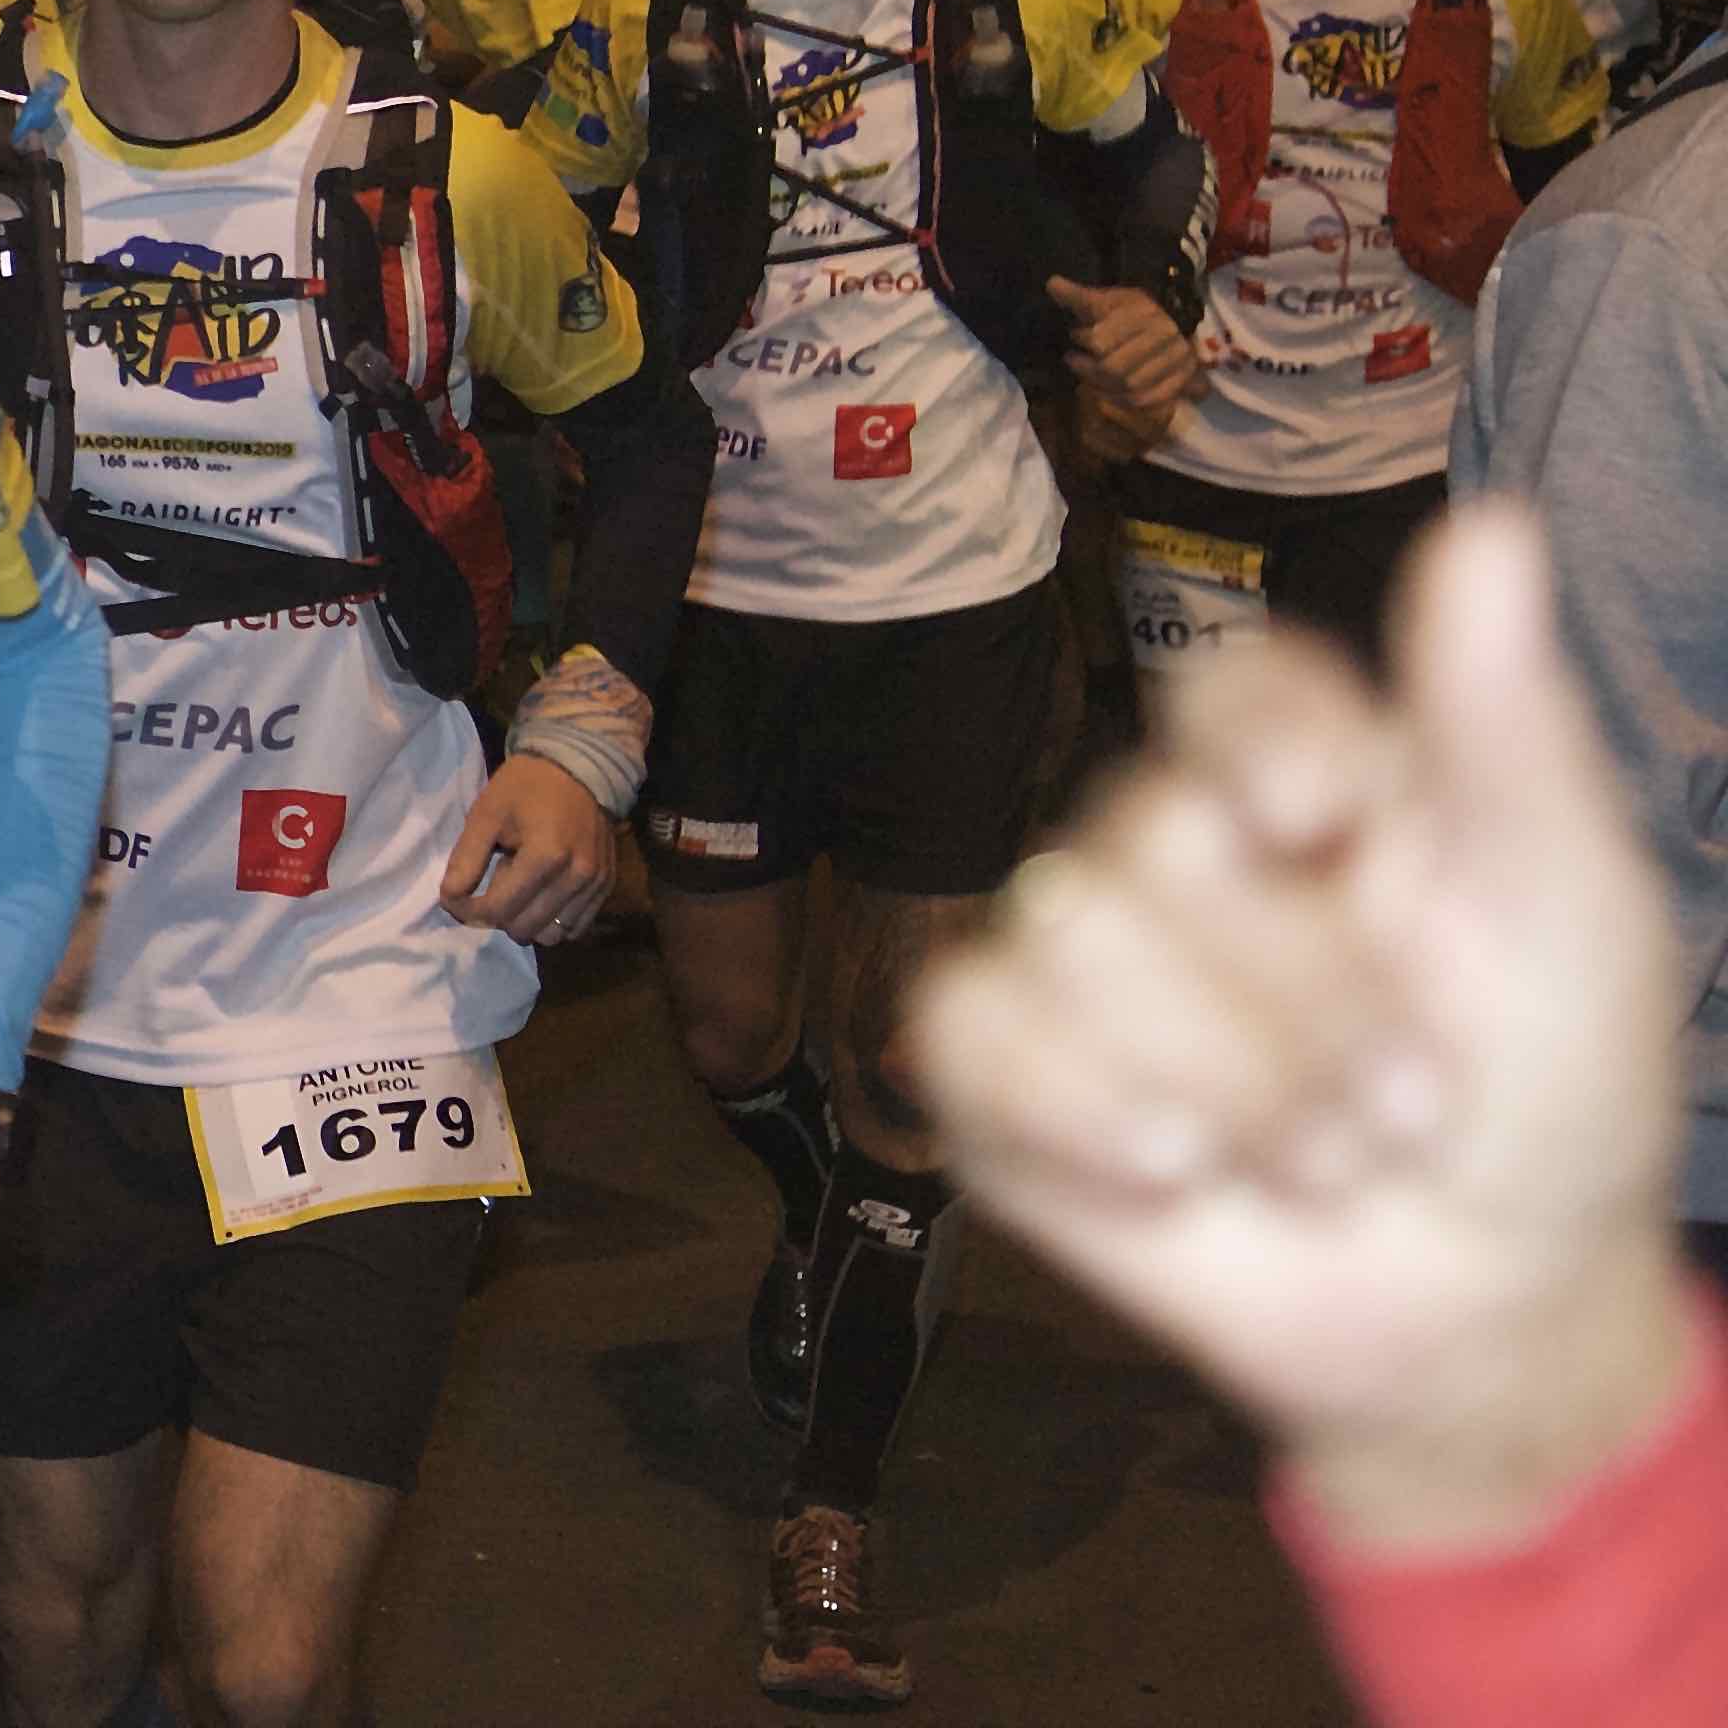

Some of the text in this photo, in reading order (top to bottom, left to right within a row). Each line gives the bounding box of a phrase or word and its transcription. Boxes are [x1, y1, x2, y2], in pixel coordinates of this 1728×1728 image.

[1276, 286, 1405, 315] CEPAC
[728, 336, 881, 377] CEPAC
[99, 826, 152, 869] DF
[312, 1076, 420, 1107] PIGNEROL
[261, 1095, 476, 1179] 1679
